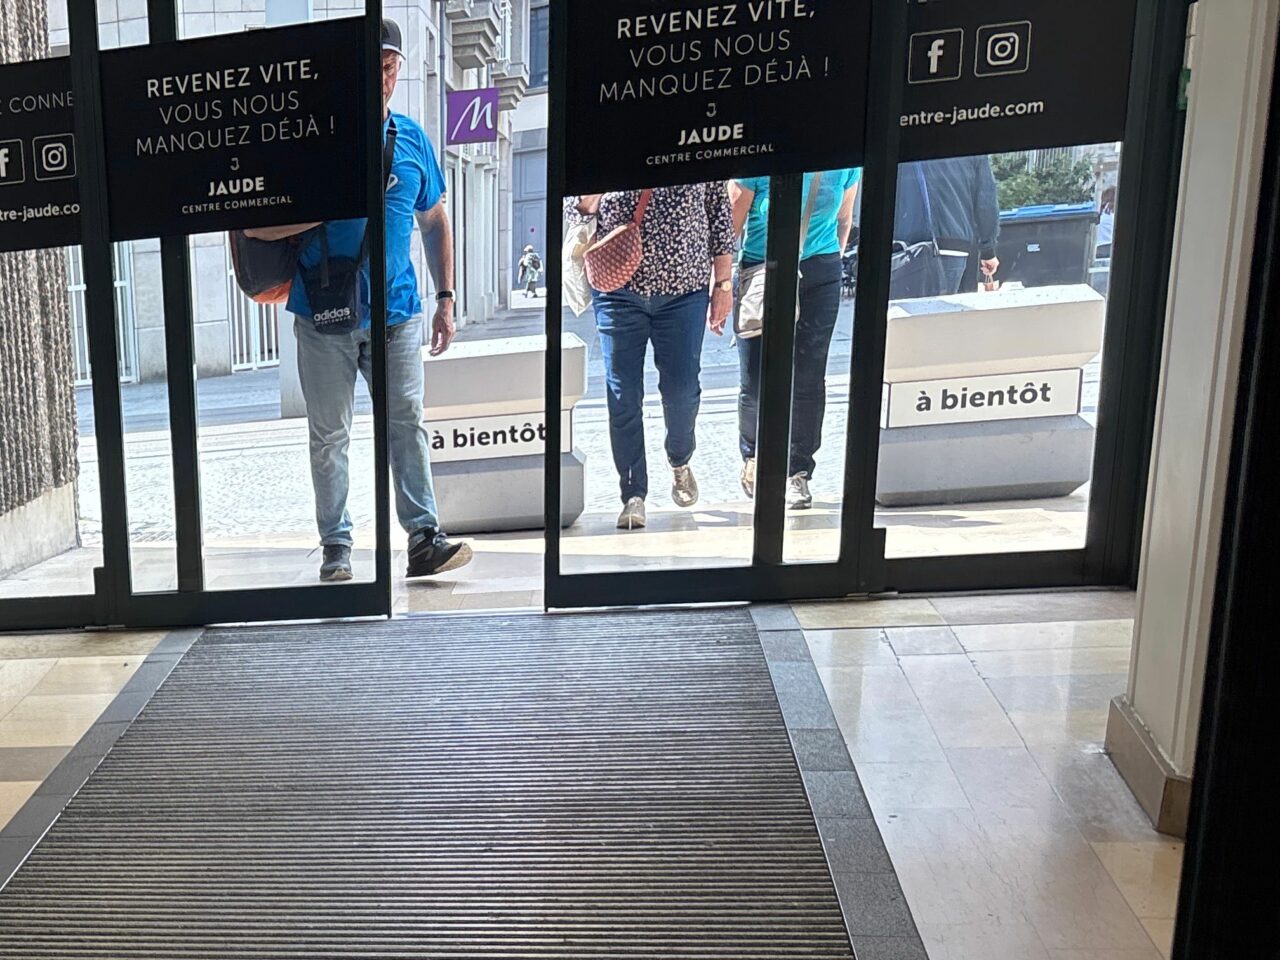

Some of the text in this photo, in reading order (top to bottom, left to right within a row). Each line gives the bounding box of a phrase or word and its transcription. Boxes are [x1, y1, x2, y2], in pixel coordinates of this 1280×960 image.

[617, 0, 815, 39] REVENEZ VITE,
[629, 29, 790, 68] VOUS NOUS
[147, 59, 319, 98] REVENEZ VITE,
[600, 67, 732, 103] MANQUEZ
[744, 55, 811, 86] DÉJÀ
[9, 91, 73, 113] CONNE
[159, 90, 299, 125] VOUS NOUS
[900, 101, 1044, 127] entre-jaude.com
[451, 96, 493, 140] M
[136, 125, 251, 156] MANQUEZ
[261, 114, 320, 142] DÉJÀ
[678, 123, 744, 146] JAUDE
[646, 144, 774, 165] CENTRE COMMERCIAL
[208, 177, 265, 196] JAUDE
[182, 195, 292, 214] CENTRE COMMERCIAL
[314, 307, 350, 321] adidas
[916, 382, 1051, 411] à bientôt
[431, 422, 547, 450] à bientôt
